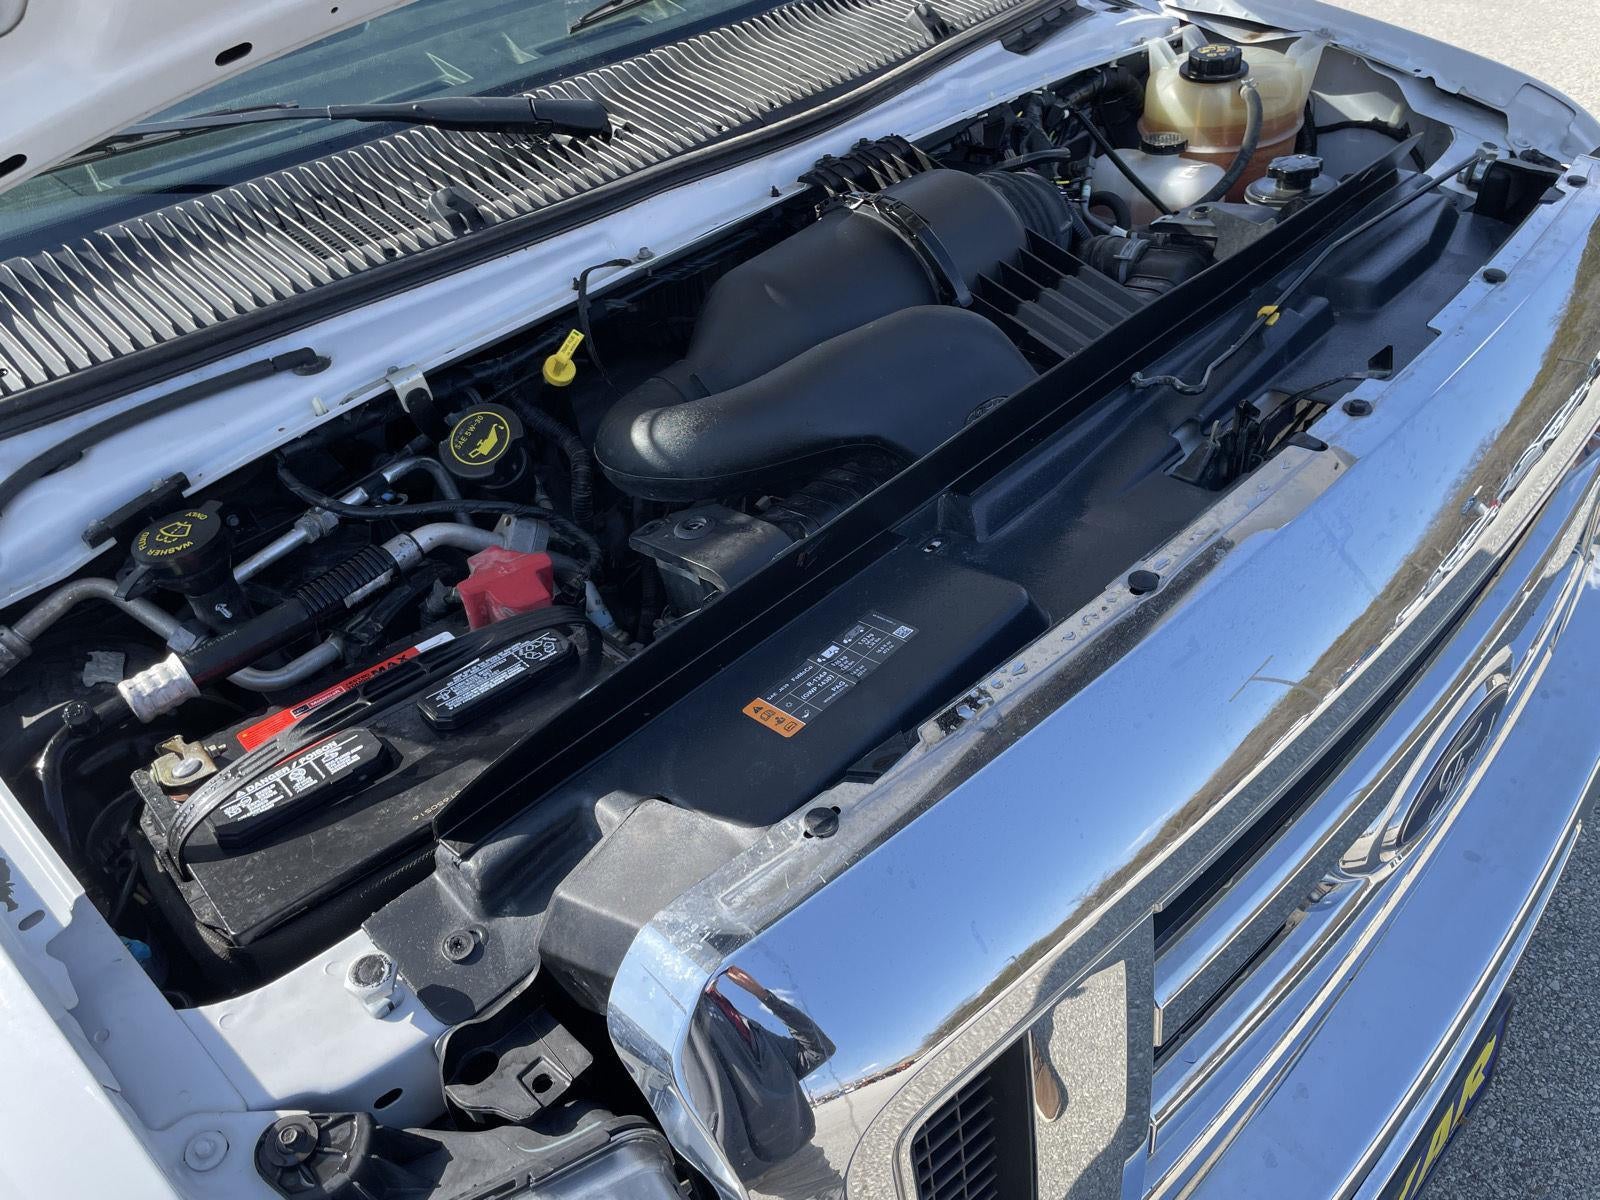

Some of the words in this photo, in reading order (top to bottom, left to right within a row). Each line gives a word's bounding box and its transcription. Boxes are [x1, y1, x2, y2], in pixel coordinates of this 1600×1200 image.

[455, 435, 468, 449] SAE
[465, 415, 484, 436] 5W-30
[185, 511, 208, 521] ONLY
[138, 531, 150, 551] FLUID
[147, 540, 193, 557] WASHER
[831, 680, 846, 692] PAG
[246, 768, 291, 792] DANGER
[298, 741, 338, 763] POISON
